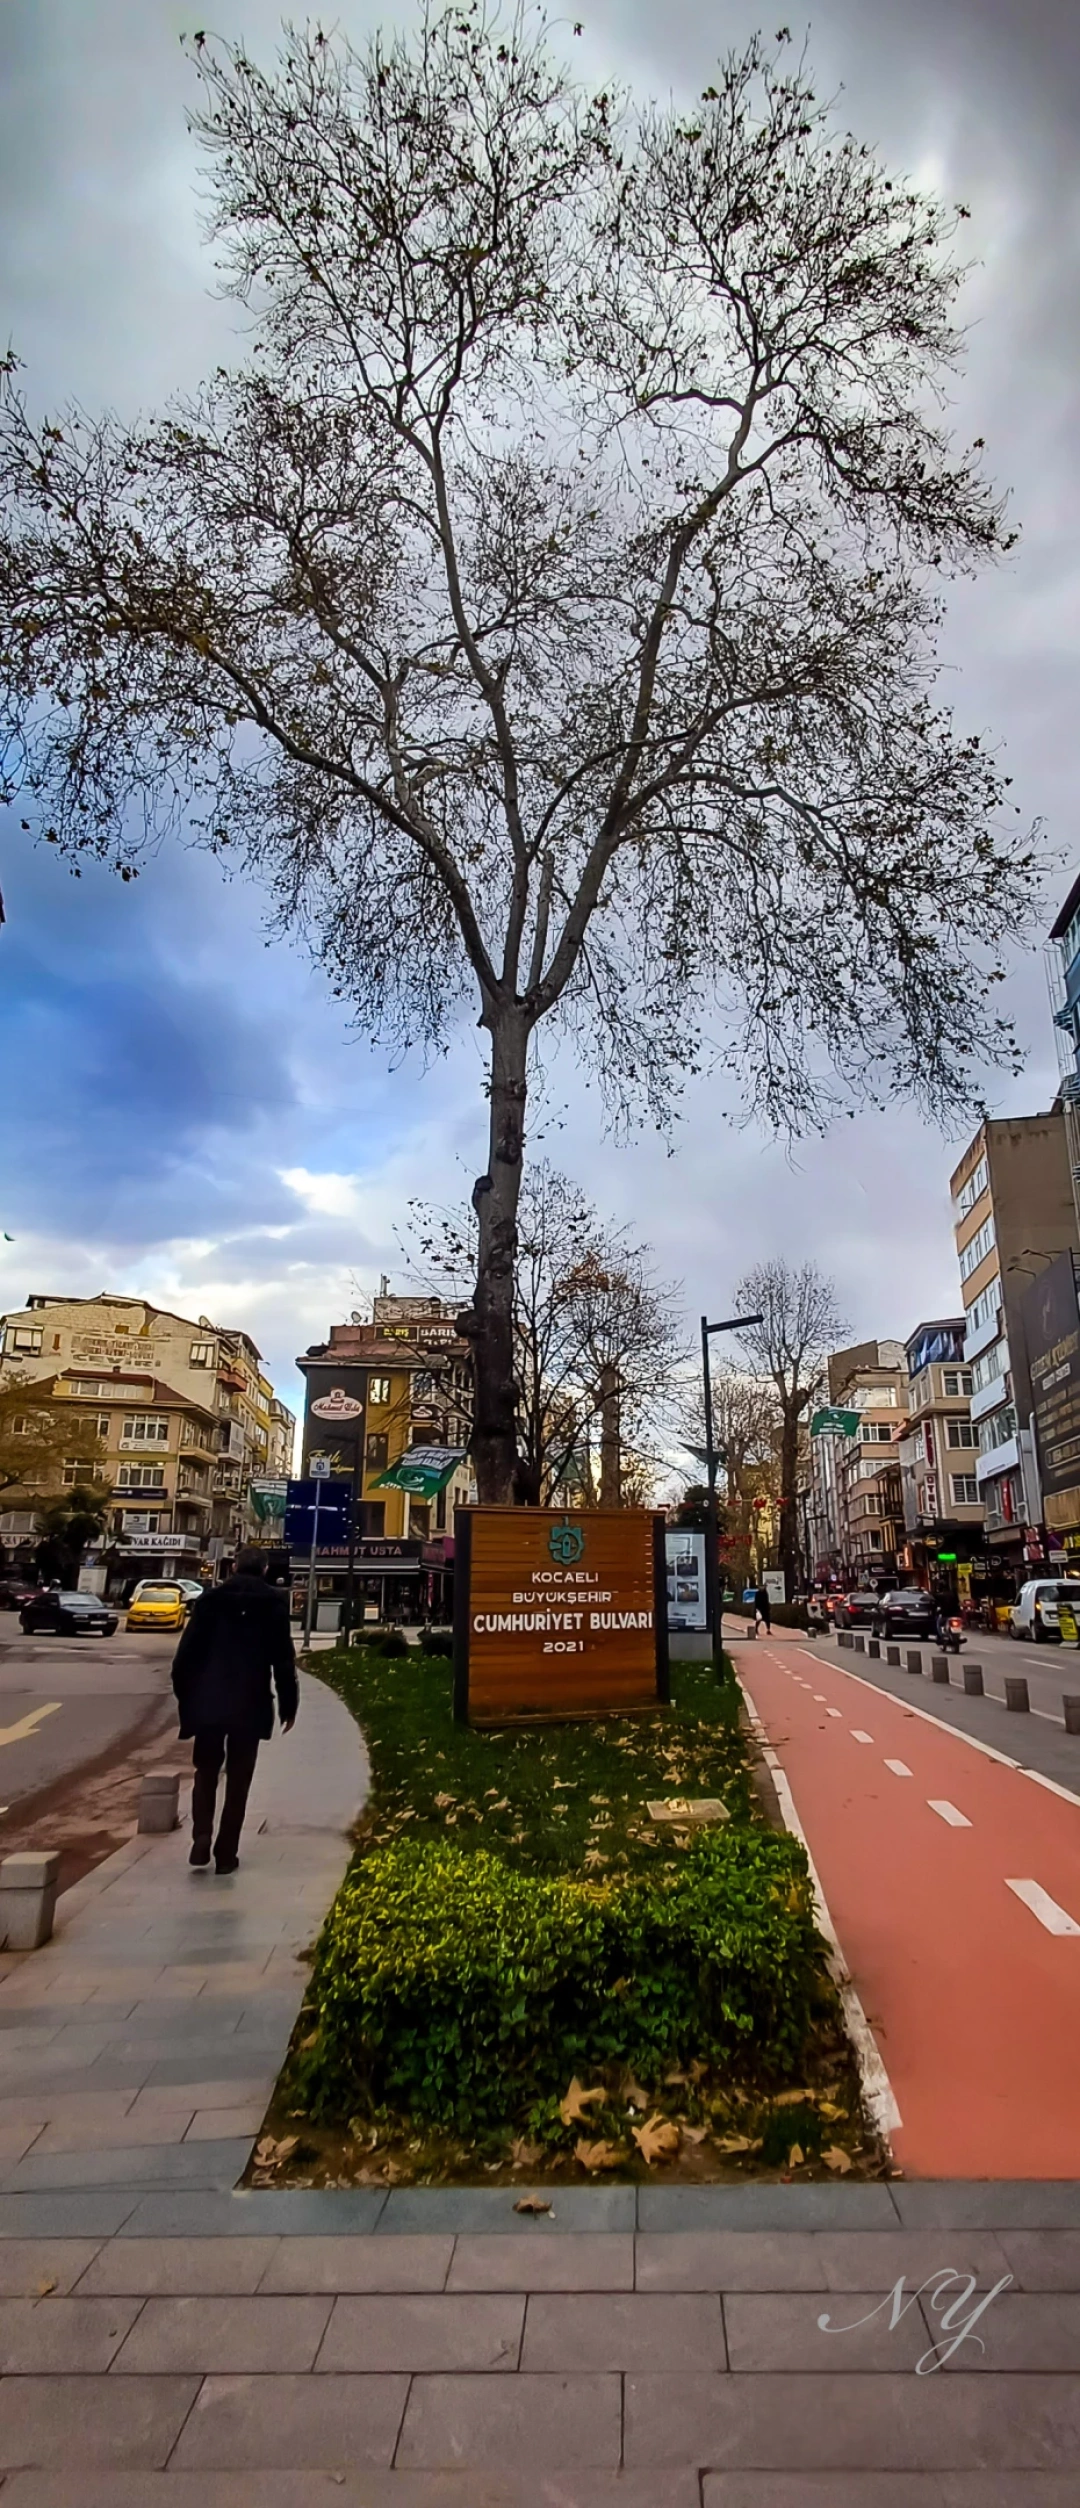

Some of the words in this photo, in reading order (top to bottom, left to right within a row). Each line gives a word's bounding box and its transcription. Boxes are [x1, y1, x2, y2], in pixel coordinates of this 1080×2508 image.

[370, 1545, 402, 1556] USTA
[473, 1608, 583, 1632] CUMHURİYET
[590, 1611, 653, 1630] BULVARI
[542, 1640, 584, 1653] 2021
